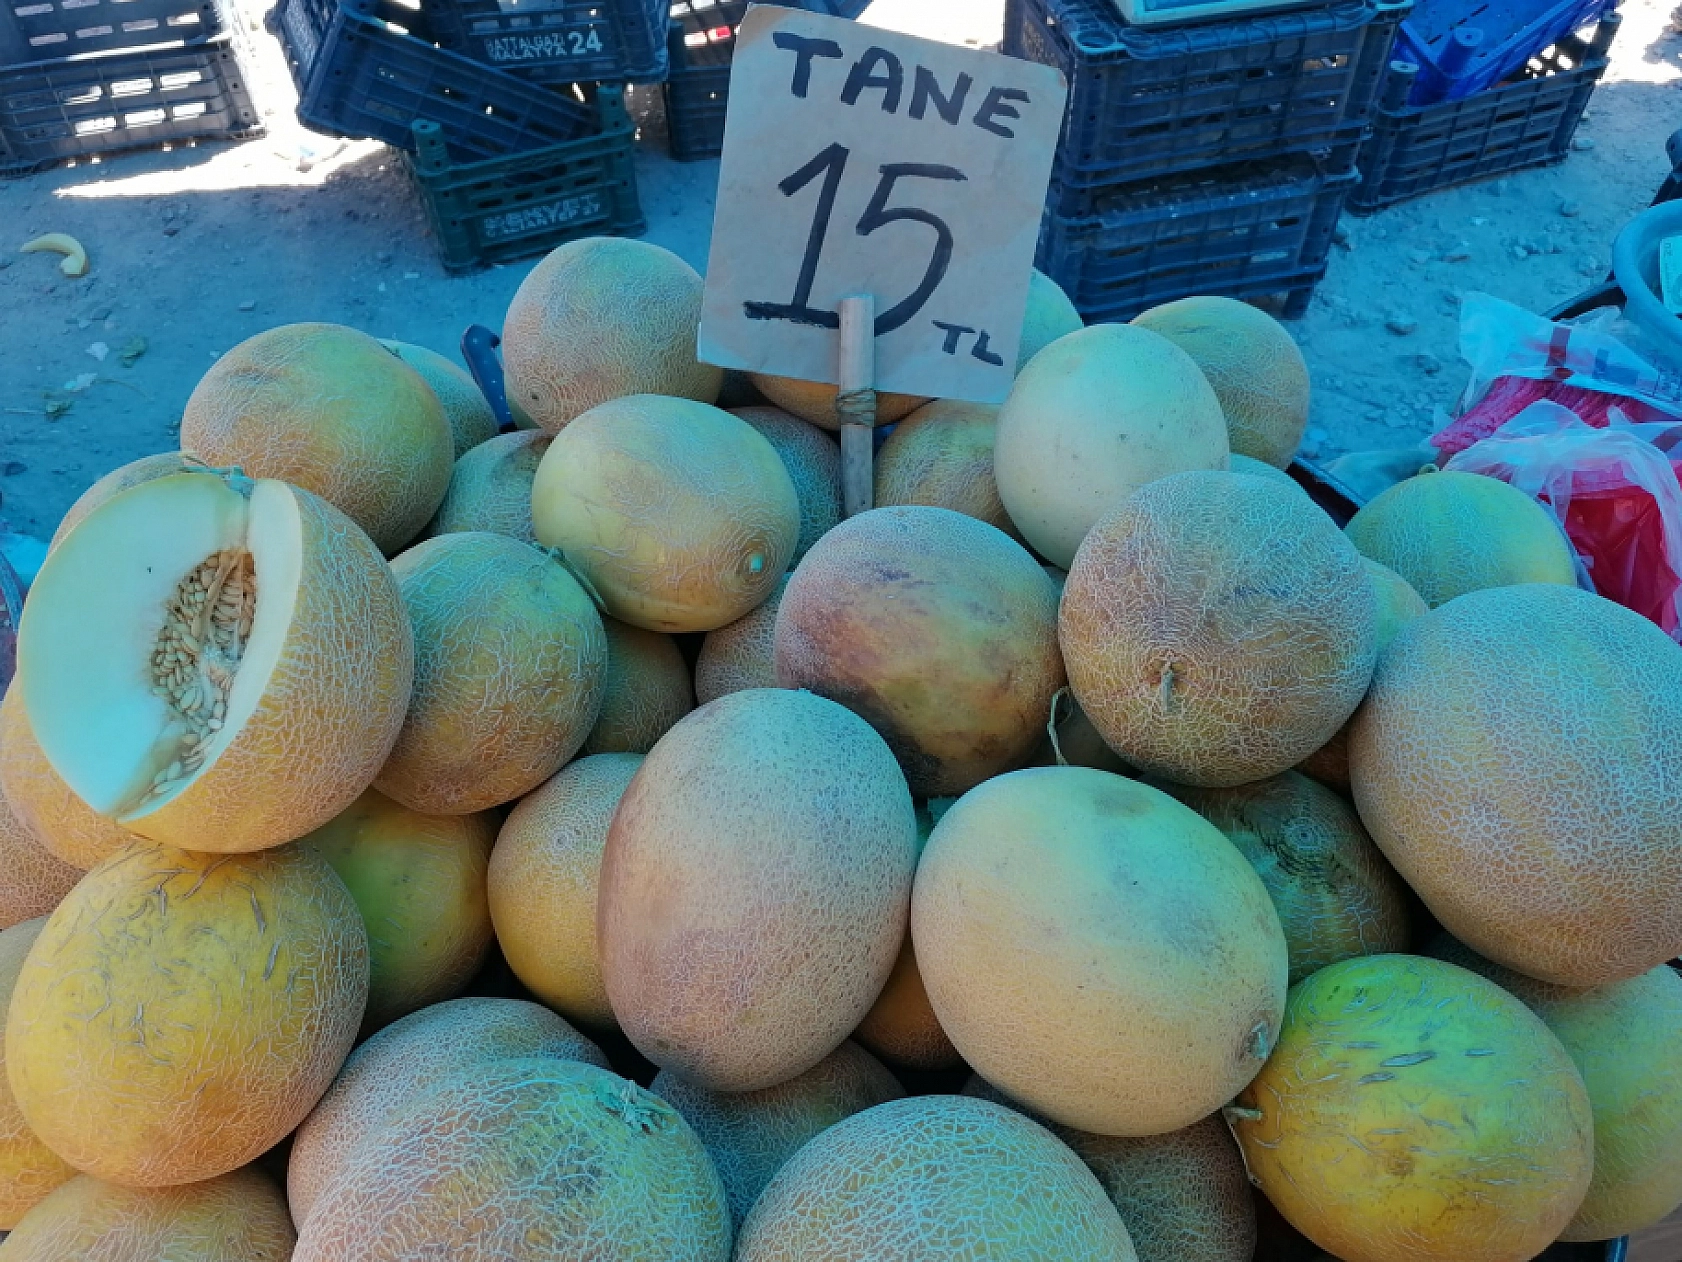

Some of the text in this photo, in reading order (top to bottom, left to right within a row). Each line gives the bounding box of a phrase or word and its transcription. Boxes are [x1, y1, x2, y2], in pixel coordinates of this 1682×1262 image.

[567, 29, 603, 54] 24
[772, 31, 1031, 139] TANE
[743, 141, 1004, 366] 15 TL
